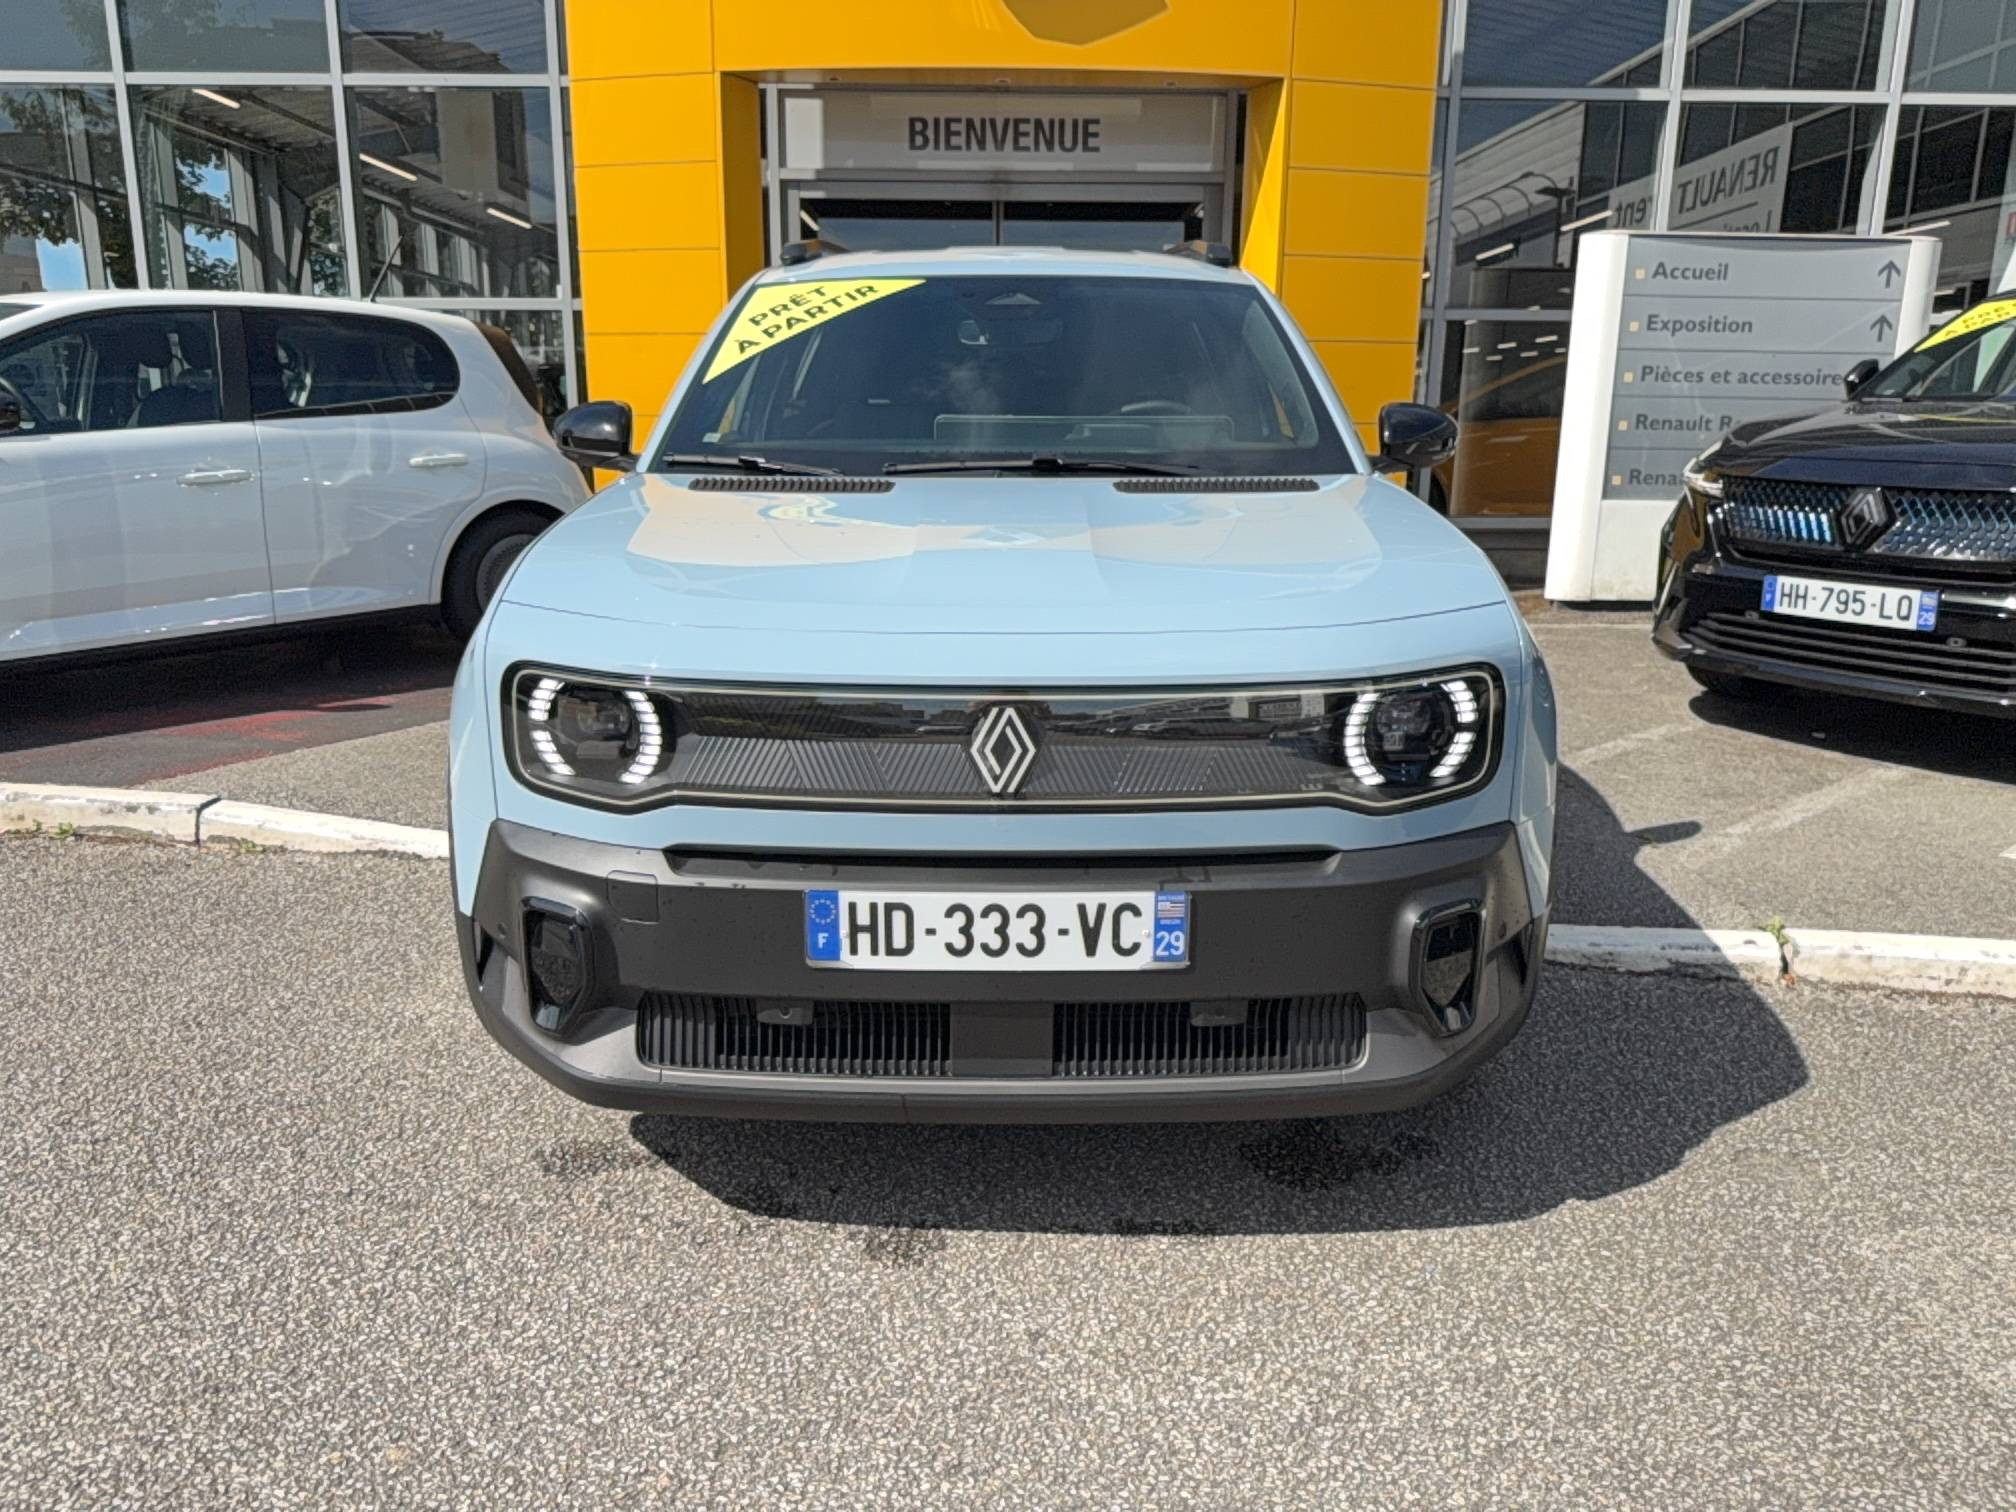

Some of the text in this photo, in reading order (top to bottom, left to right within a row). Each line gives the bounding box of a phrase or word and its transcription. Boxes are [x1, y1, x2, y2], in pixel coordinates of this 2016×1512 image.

[908, 117, 1100, 152] BIENVENUE
[1651, 261, 1729, 280] Accueil
[748, 286, 827, 327] PRÊT
[761, 285, 879, 339] PARTIR
[1646, 314, 1753, 336] Exposition
[1640, 364, 1844, 386] Pièces et accessoire
[1635, 413, 1713, 431] Renault
[1779, 581, 1913, 622] HH-795-LQ
[1918, 611, 1935, 626] 29
[818, 932, 827, 949] F
[848, 902, 1143, 958] HD-333-VC
[1155, 930, 1185, 956] 29
